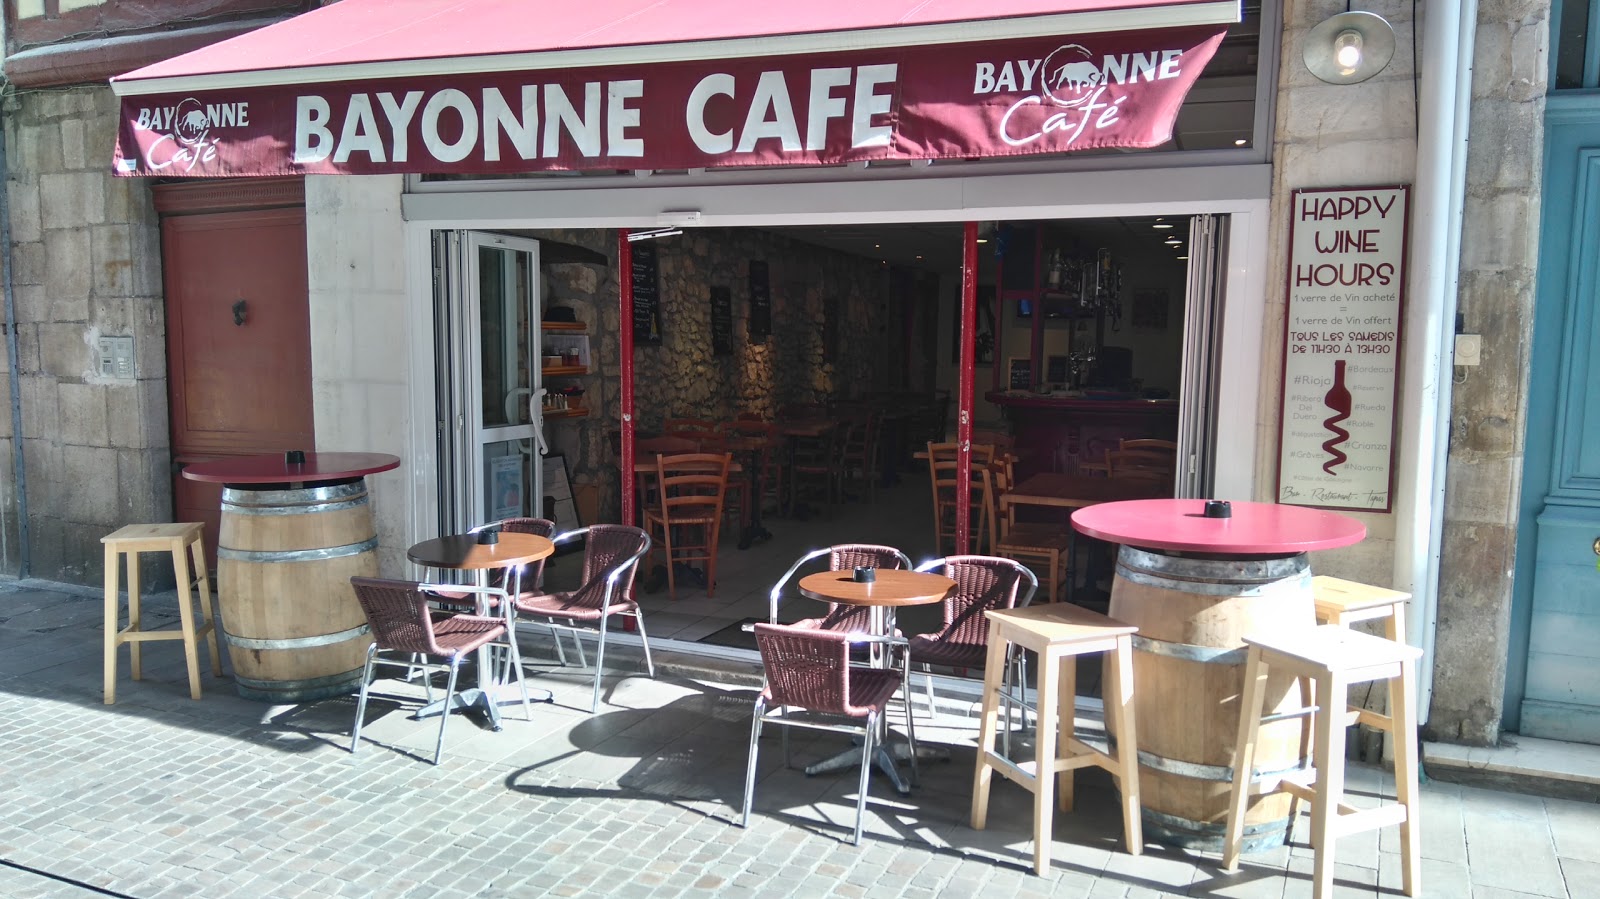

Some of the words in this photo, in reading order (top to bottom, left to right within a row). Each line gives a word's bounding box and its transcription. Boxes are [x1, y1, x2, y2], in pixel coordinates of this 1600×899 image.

[294, 79, 644, 164] BAYONNE
[686, 63, 898, 155] CAFE
[999, 86, 1127, 146] Café
[147, 129, 220, 172] Café
[1301, 195, 1396, 221] HAPPY
[1314, 229, 1380, 254] WINE
[1296, 262, 1395, 287] HOURS
[1329, 294, 1342, 302] de
[1344, 293, 1360, 302] Vin
[1362, 293, 1396, 302] acheté
[1301, 317, 1328, 325] verre
[1330, 317, 1343, 325] de
[1345, 316, 1361, 325] Vin
[1363, 316, 1392, 325] offert
[1290, 331, 1319, 342] TOUS
[1322, 331, 1345, 342] LES
[1348, 331, 1395, 342] SAMEDIS
[1292, 344, 1307, 354] DE
[1311, 344, 1341, 354] 11H30
[1344, 342, 1353, 354] À
[1357, 344, 1391, 354] 13H30
[1348, 365, 1394, 373] #Bordeaux
[1294, 375, 1331, 388] #Rioja
[1299, 403, 1313, 411] Del
[1354, 403, 1386, 411] #Rueda
[1292, 412, 1318, 420] Duero
[1346, 420, 1374, 428] #Roble
[1344, 441, 1388, 451] #Crianza
[1344, 463, 1384, 472] #Navarre
[1280, 486, 1300, 501] Bar
[1312, 487, 1358, 502] Restaurant
